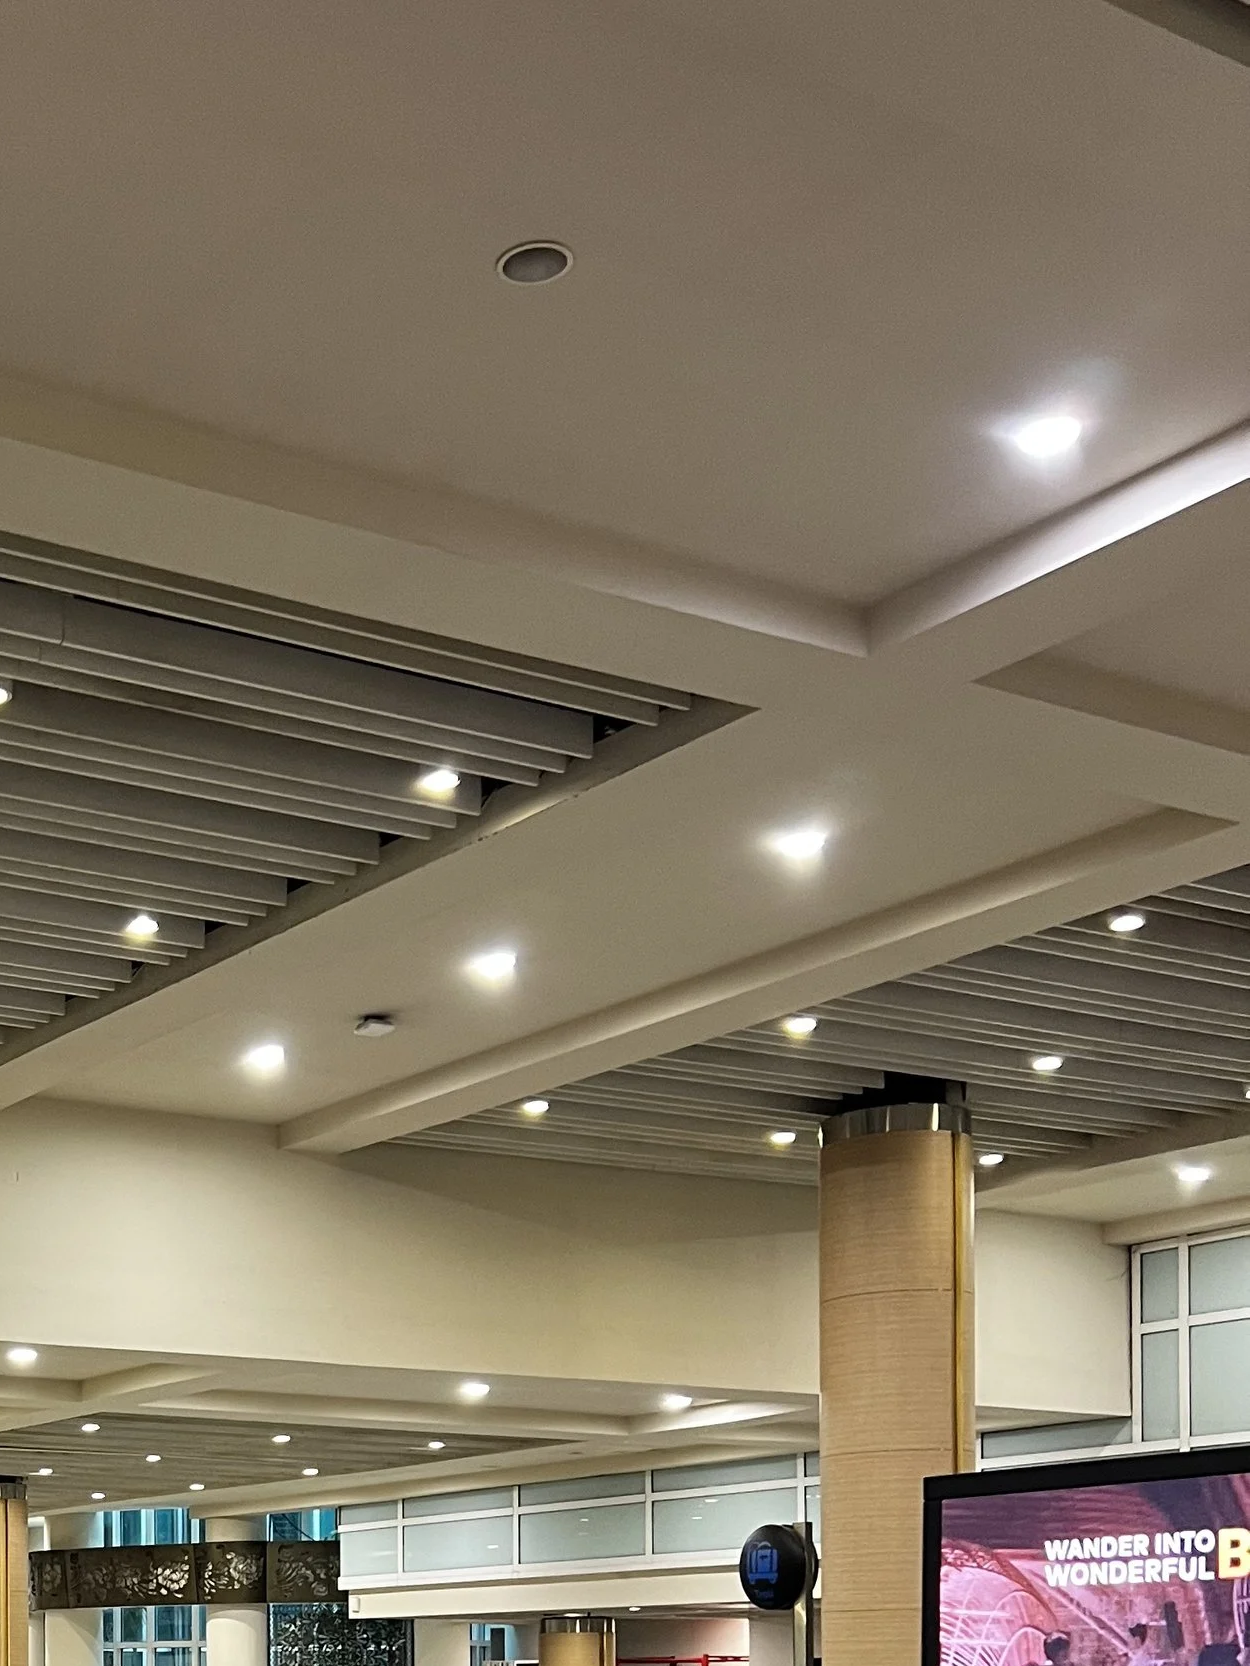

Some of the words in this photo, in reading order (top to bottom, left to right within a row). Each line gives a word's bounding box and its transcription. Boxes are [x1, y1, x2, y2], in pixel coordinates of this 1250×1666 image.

[1044, 1534, 1149, 1561] WANDER
[1154, 1529, 1216, 1555] INTO
[1044, 1556, 1215, 1587] WONDERFUL
